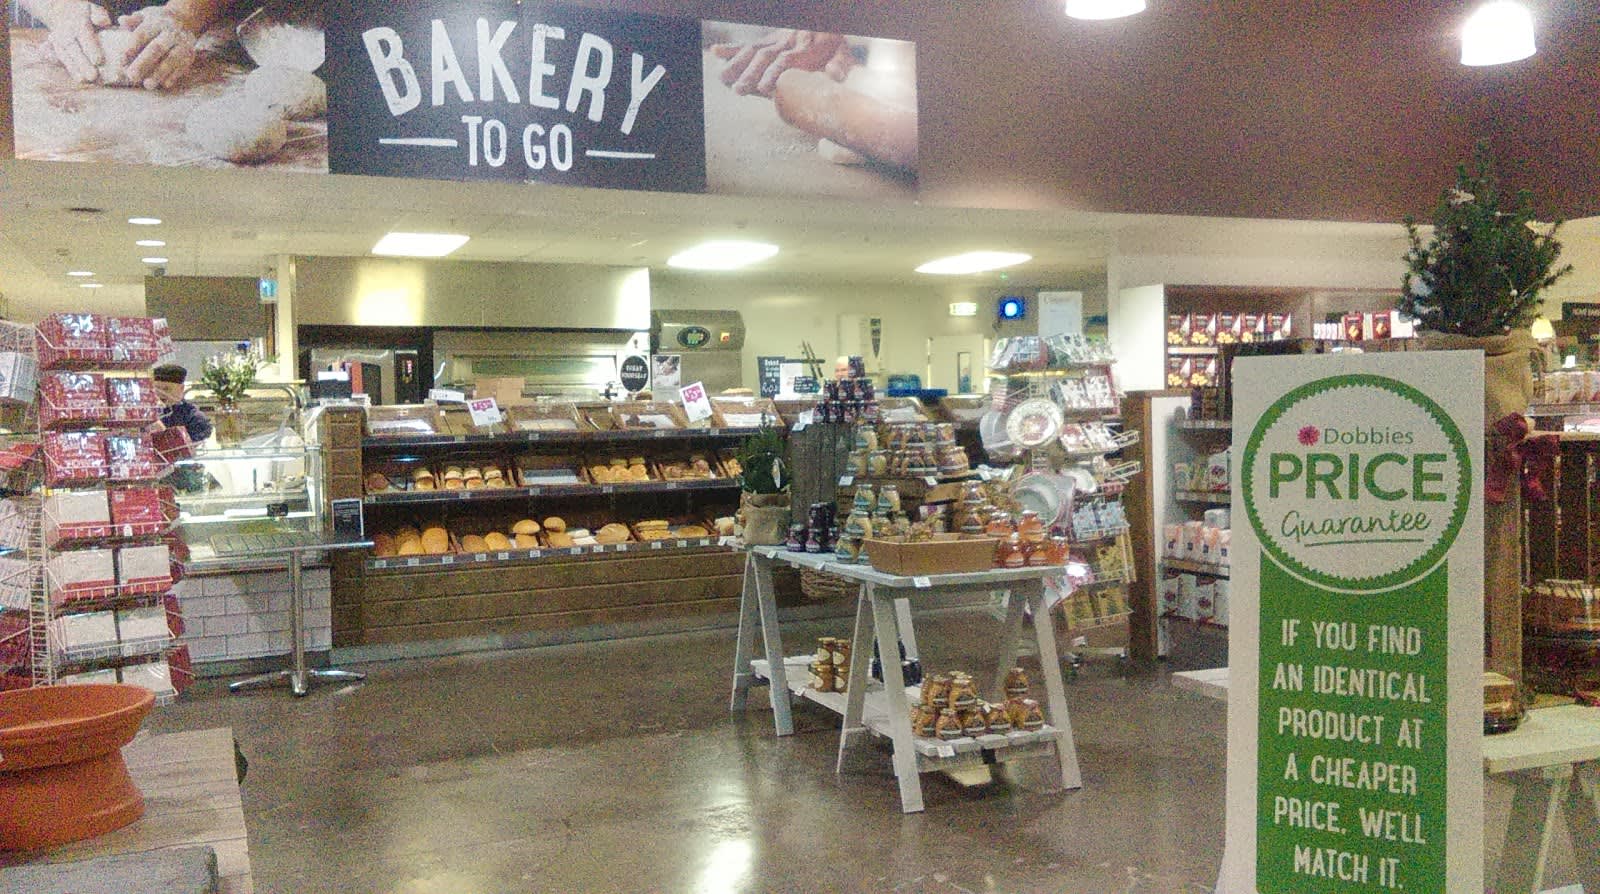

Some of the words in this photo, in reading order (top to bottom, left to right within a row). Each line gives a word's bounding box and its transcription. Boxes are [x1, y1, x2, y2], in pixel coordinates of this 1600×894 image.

[362, 17, 666, 135] BAKERY
[461, 115, 507, 167] TO
[523, 123, 573, 171] GO
[1323, 426, 1414, 445] Dobbies
[1269, 452, 1448, 502] PRICE
[1280, 509, 1431, 542] Guarantee
[1281, 619, 1300, 646] IF
[1312, 621, 1357, 650] YOU
[1367, 625, 1421, 655] FIND
[1273, 662, 1304, 692] AN
[1313, 665, 1431, 703] IDENTICAL
[1278, 707, 1384, 745] PRODUCT
[1397, 719, 1424, 749] AT
[1284, 753, 1299, 781] A
[1310, 755, 1418, 796] CHEAPER
[1294, 844, 1368, 884] MATCH
[1379, 857, 1405, 889] IT.
